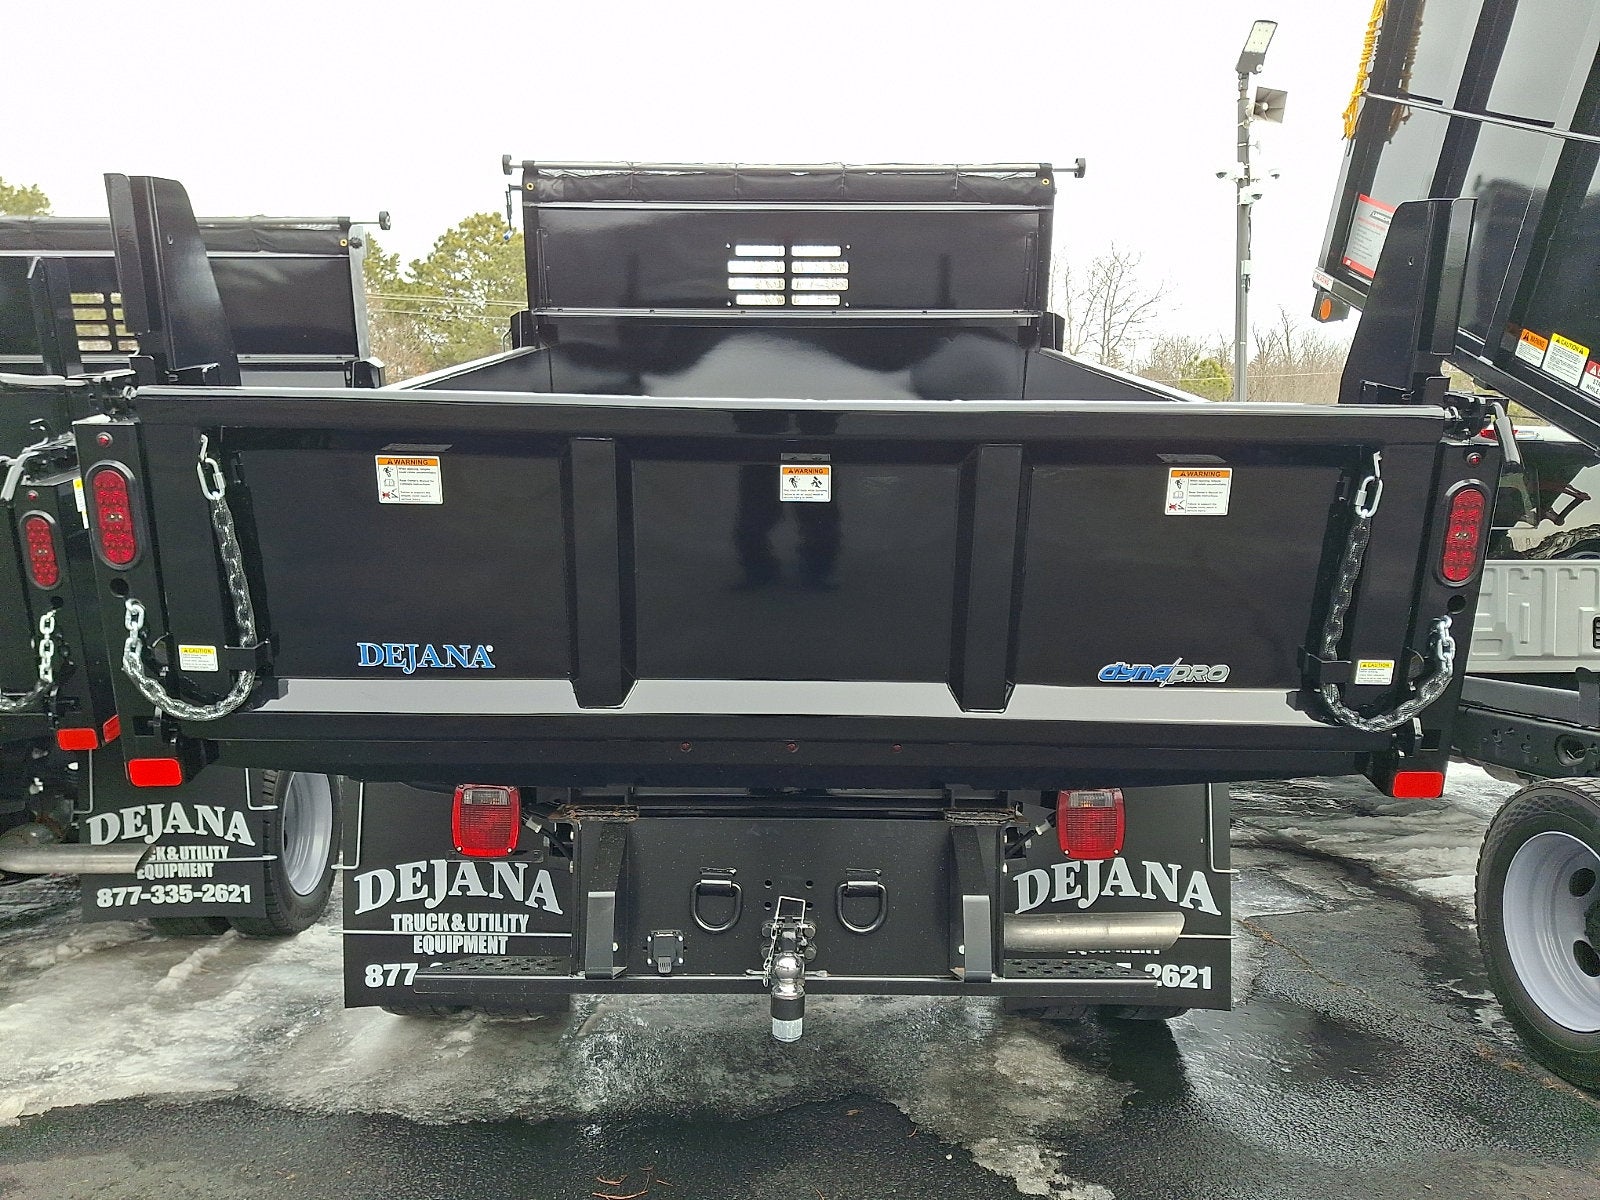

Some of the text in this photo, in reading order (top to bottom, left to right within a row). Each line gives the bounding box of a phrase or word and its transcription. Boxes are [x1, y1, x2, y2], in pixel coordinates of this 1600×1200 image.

[356, 642, 496, 675] DEJANA
[85, 802, 256, 847] DEJANA
[96, 883, 251, 908] 877-335-2621
[353, 859, 564, 915] DEJANA
[1012, 857, 1222, 916] DEJANA
[413, 935, 509, 956] EQUIPMENT
